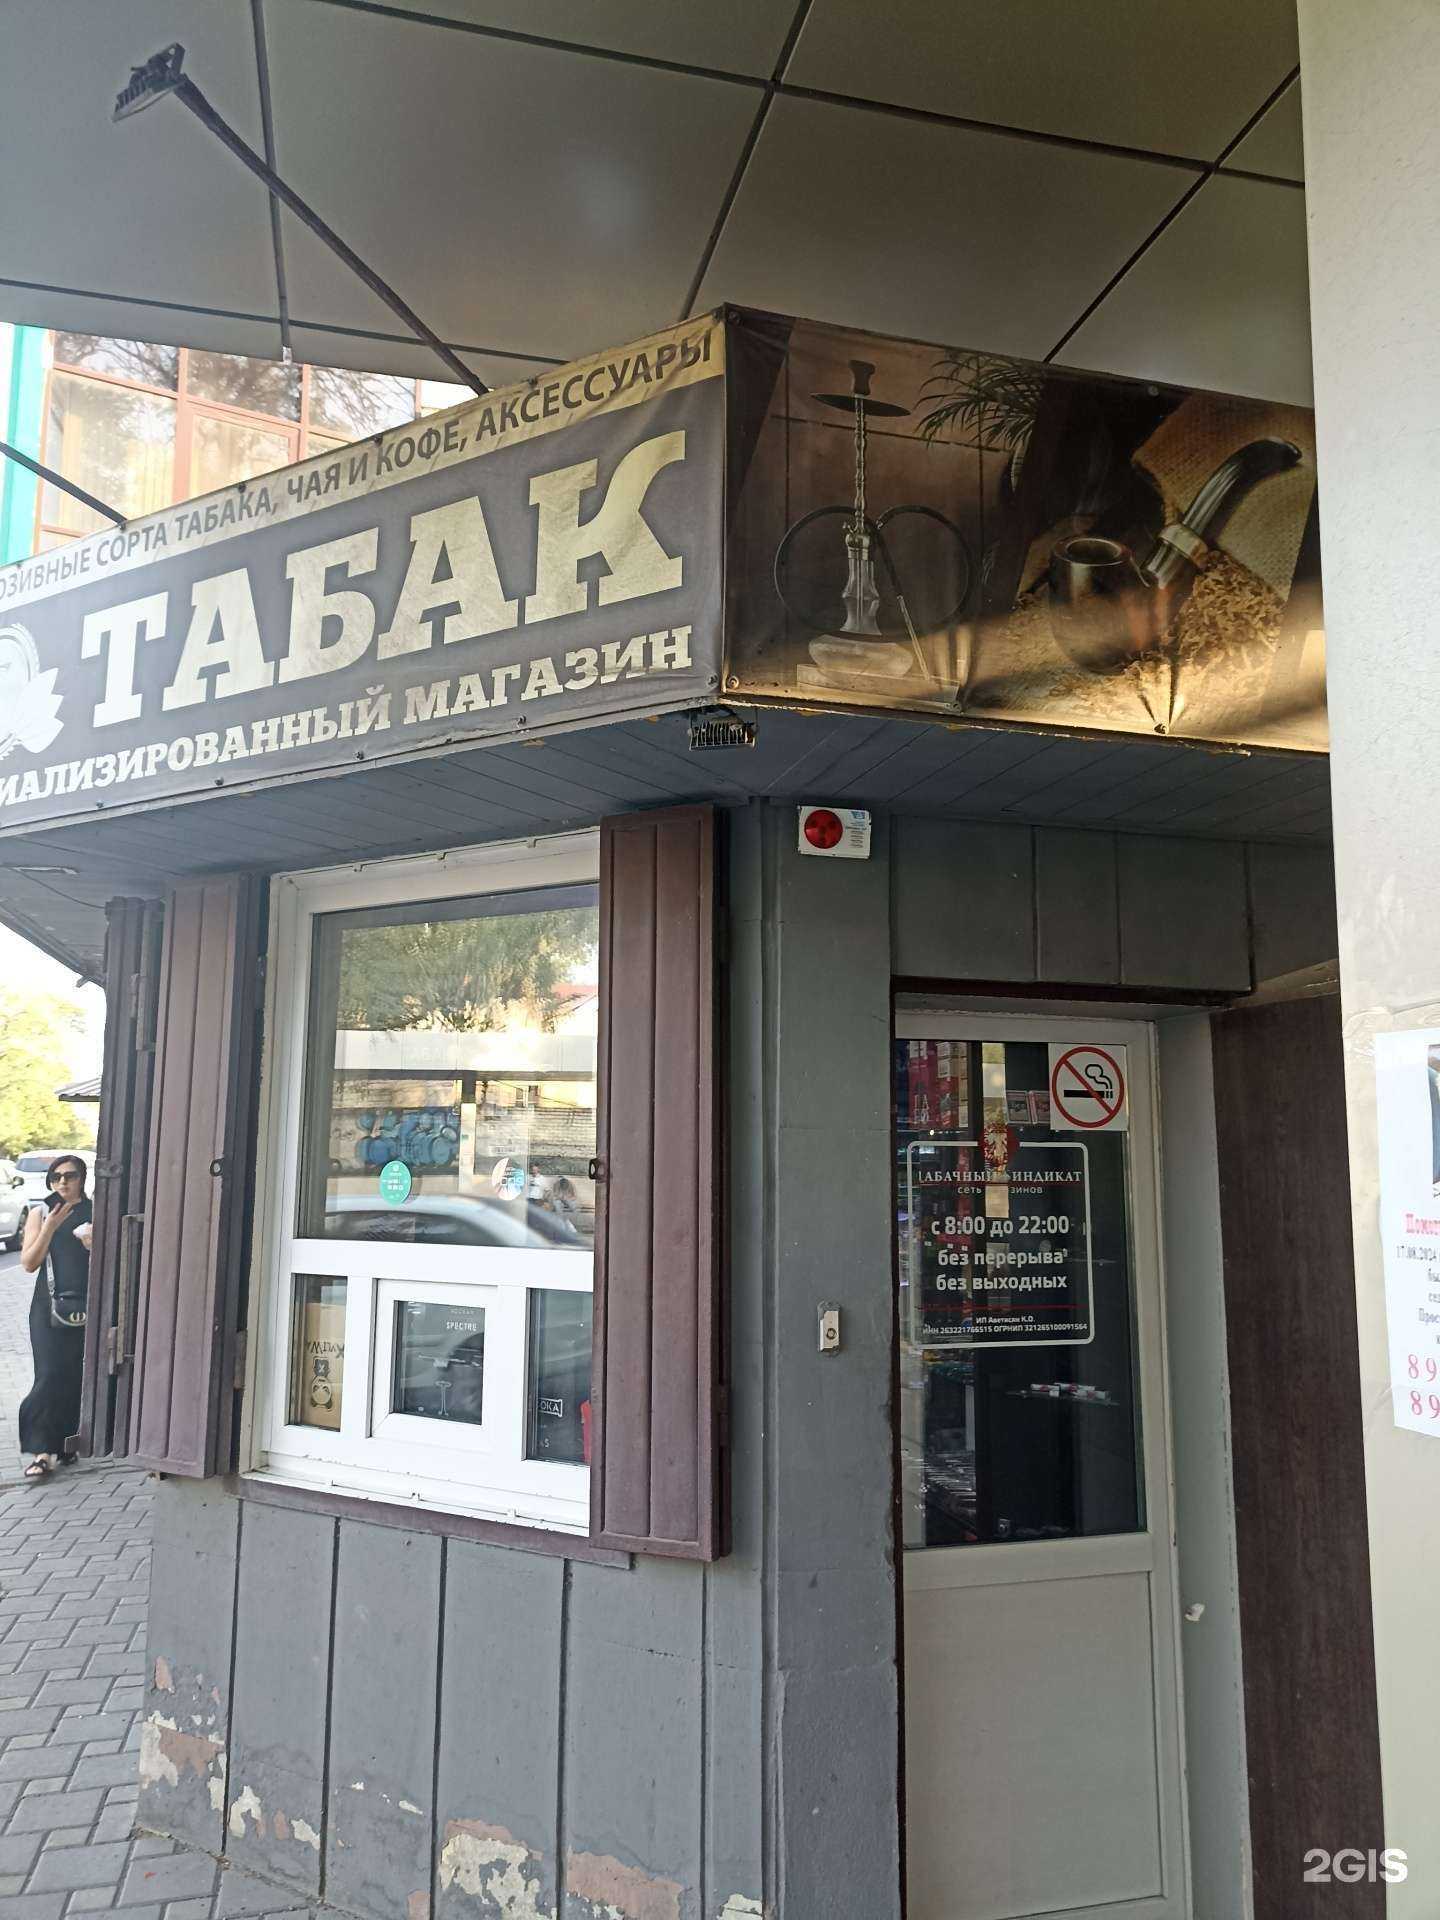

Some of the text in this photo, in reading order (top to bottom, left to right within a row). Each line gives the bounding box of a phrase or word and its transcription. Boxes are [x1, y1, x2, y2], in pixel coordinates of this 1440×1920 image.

[96, 521, 168, 566] СОРТА
[173, 486, 278, 541] ТАБАКА,
[287, 462, 341, 504] ЧАЯ
[348, 452, 369, 486] И
[375, 420, 467, 476] КОФЕ,
[475, 329, 712, 441] АКСЕССУАРЫ
[80, 430, 686, 728] ТАБАК
[403, 625, 693, 725] МАГАЗИН
[957, 1186, 982, 1195] сеть
[931, 1215, 1070, 1237] с 8:00 до 22:00
[938, 1249, 1064, 1268] без перерыва
[936, 1273, 1068, 1292] без выходных
